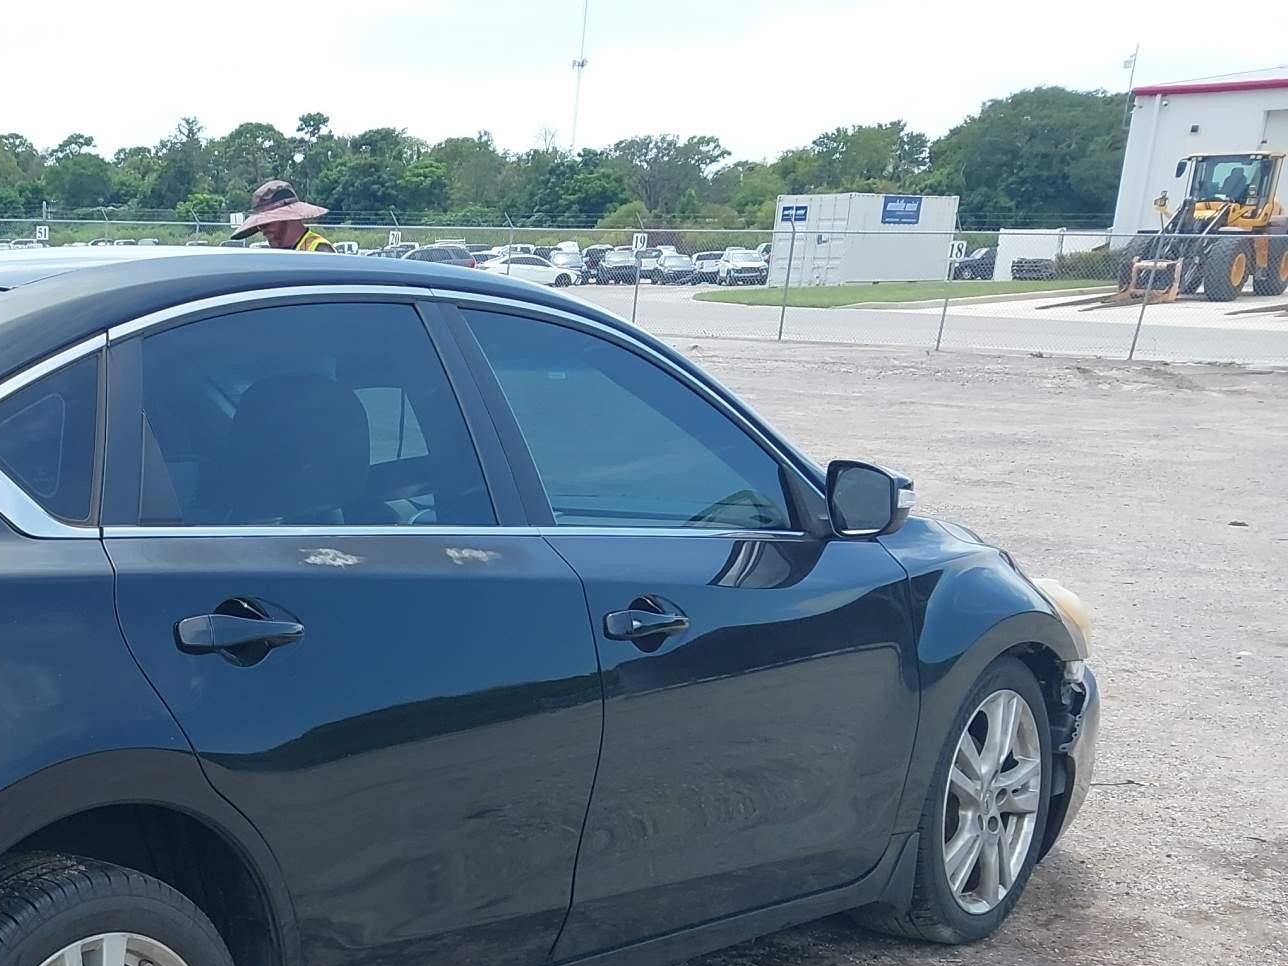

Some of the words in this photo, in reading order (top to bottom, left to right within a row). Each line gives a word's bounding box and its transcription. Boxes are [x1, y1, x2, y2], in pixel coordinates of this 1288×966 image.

[38, 227, 47, 239] 51
[391, 233, 400, 246] 20
[635, 235, 646, 249] 19
[949, 242, 964, 258] 18
